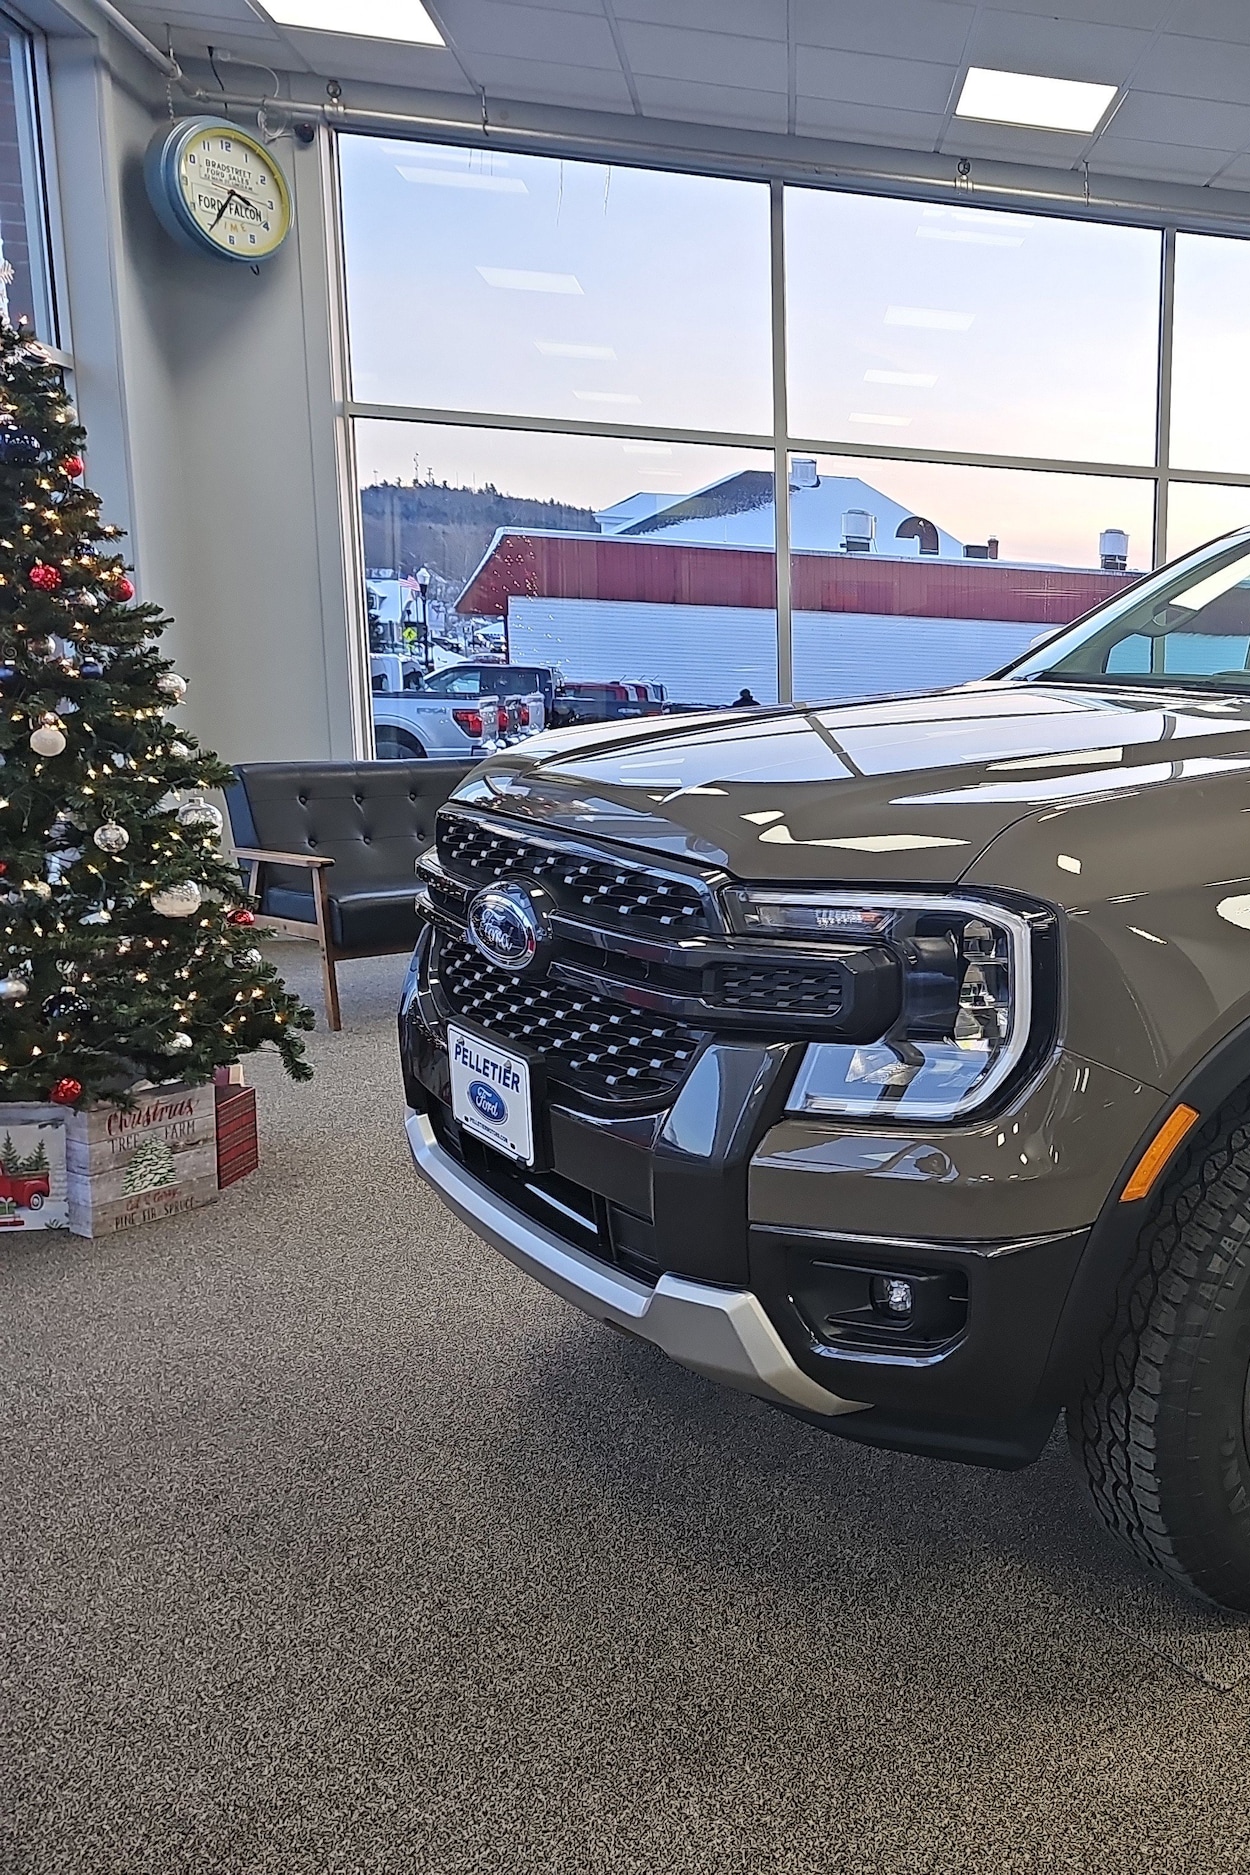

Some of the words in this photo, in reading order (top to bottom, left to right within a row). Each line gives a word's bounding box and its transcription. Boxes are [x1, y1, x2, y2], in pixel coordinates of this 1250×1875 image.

[220, 140, 231, 152] 12
[205, 158, 252, 179] BRADSTREET
[206, 168, 225, 178] FORD
[229, 174, 250, 186] SALES
[259, 175, 266, 186] 2
[198, 194, 222, 211] FORD
[229, 202, 262, 222] FALCON
[267, 201, 274, 210] 3
[228, 235, 235, 245] 6
[249, 234, 256, 244] 5
[481, 907, 513, 951] Ford
[454, 1042, 521, 1094] PELLETIER
[475, 1086, 499, 1118] Ford
[106, 1097, 199, 1137] Christmas
[108, 1133, 140, 1155] TREE
[163, 1120, 196, 1140] FARM
[115, 1212, 137, 1230] PINE
[142, 1207, 157, 1222] FIR
[164, 1196, 195, 1216] SPRUCE
